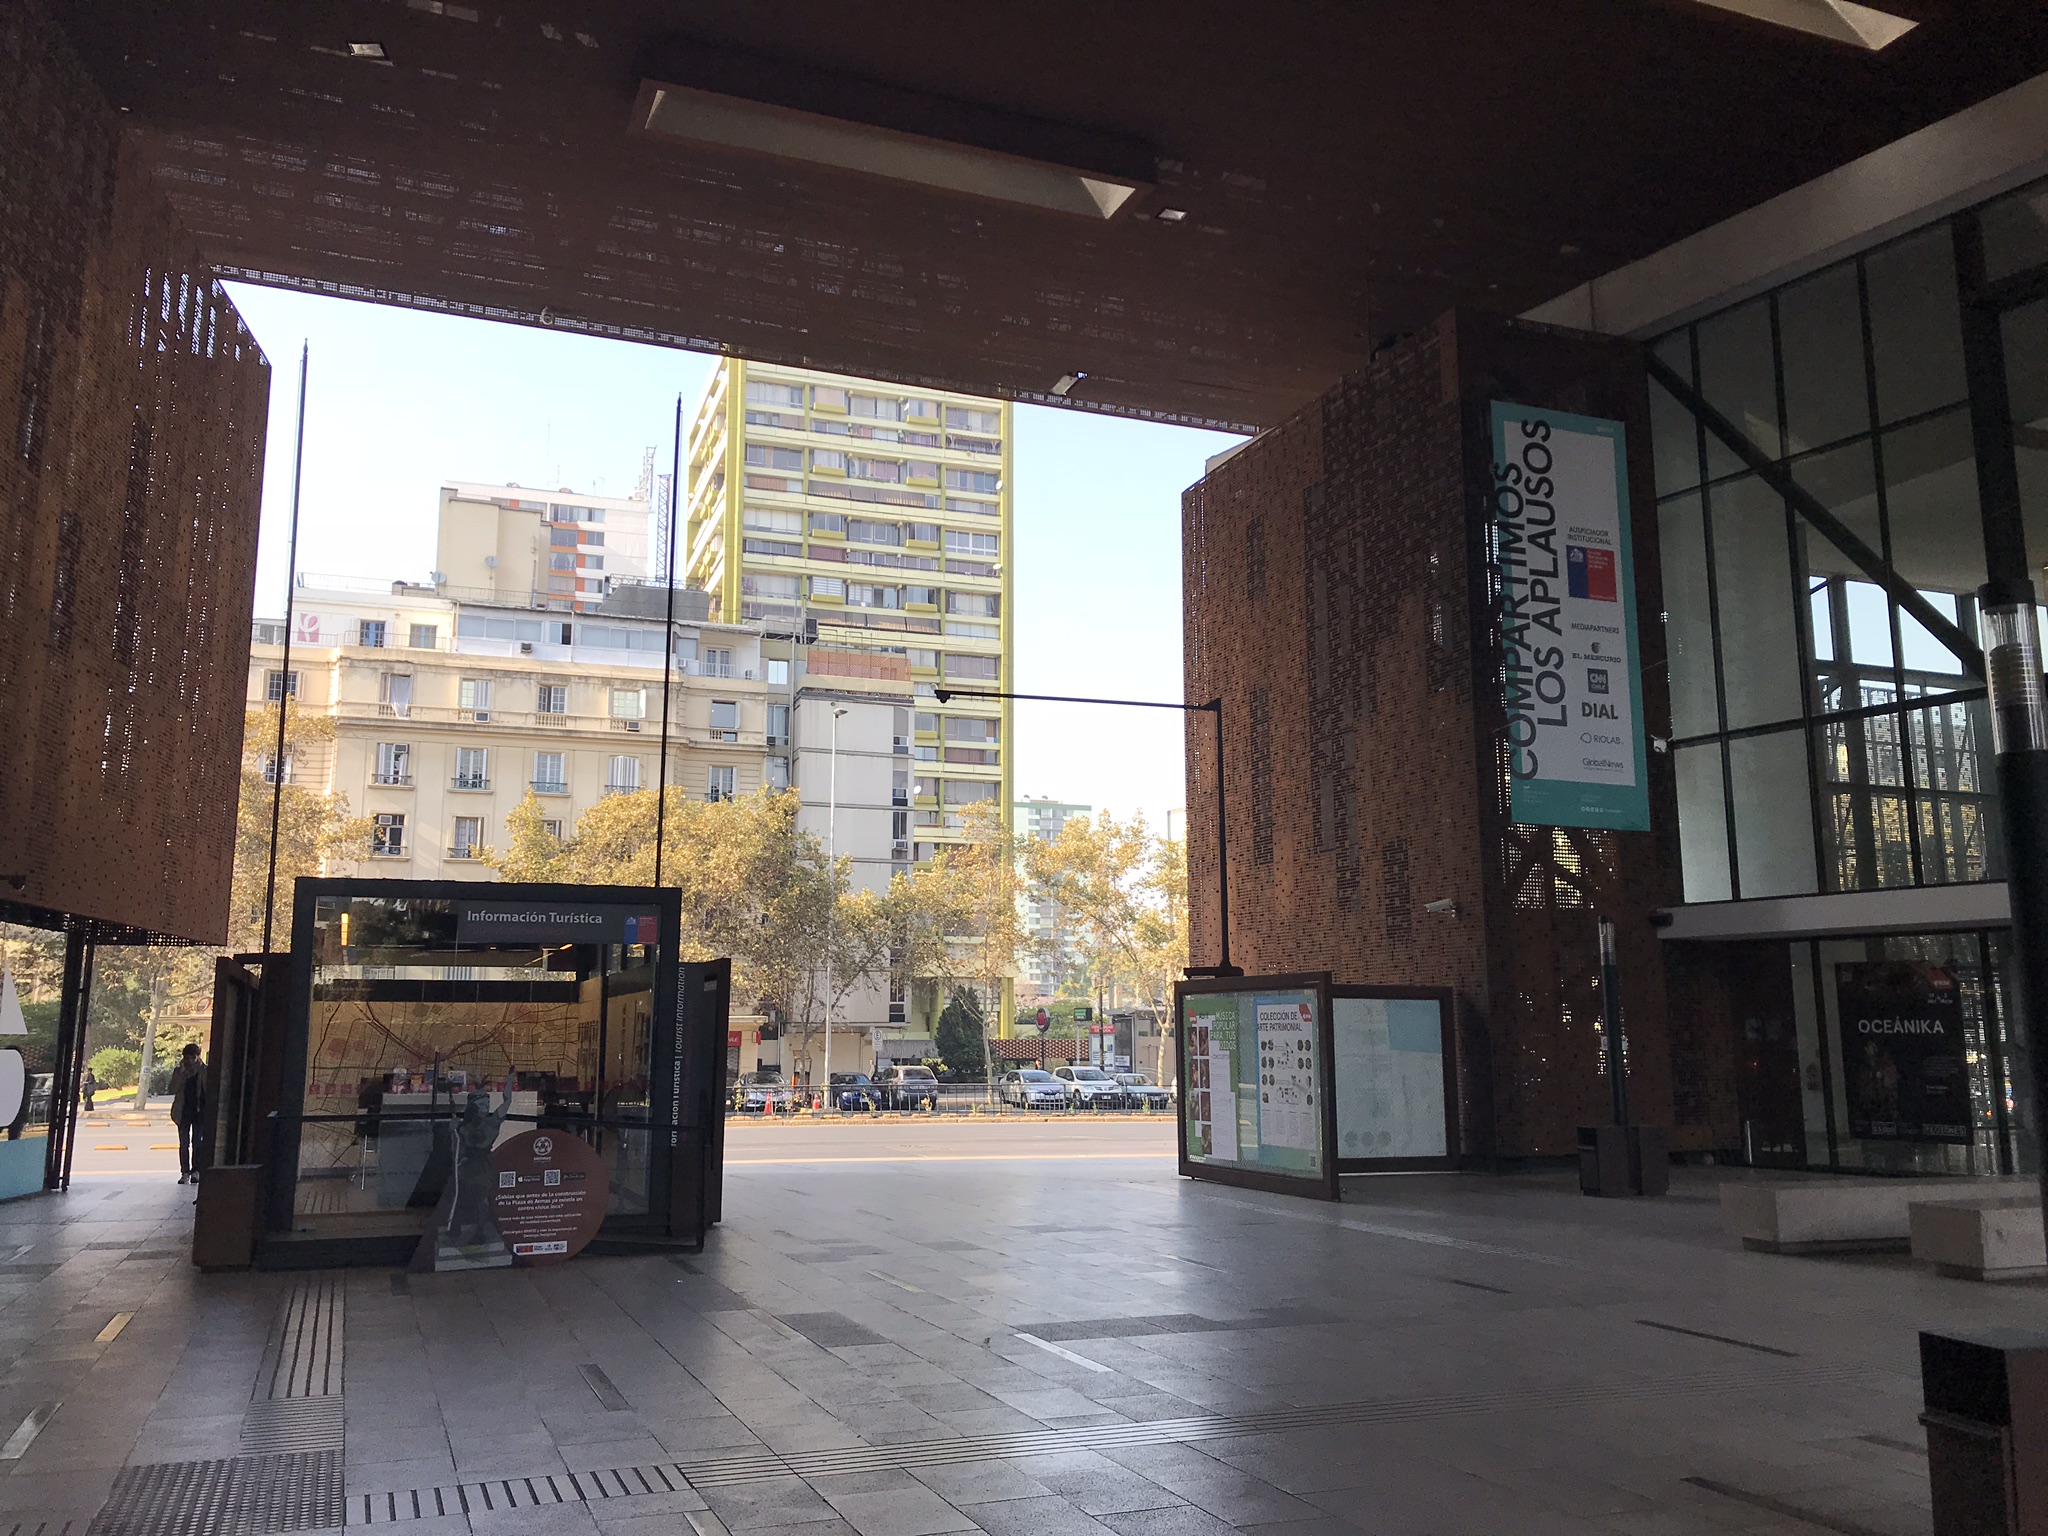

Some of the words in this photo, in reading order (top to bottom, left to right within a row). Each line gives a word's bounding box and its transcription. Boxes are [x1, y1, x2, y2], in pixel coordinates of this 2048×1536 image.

[1521, 419, 1563, 636] APLAUSOS
[1568, 526, 1610, 537] AUSPICIADOR
[1567, 534, 1612, 546] INSTITUCIONAL
[1494, 461, 1539, 781] COMPARTIMOS
[1571, 622, 1620, 635] MEDIAPARTNERS
[1584, 653, 1622, 663] MERCURIO
[1589, 672, 1607, 684] CNN
[1533, 645, 1568, 727] LOS
[1581, 701, 1619, 720] DIAL
[1582, 757, 1624, 769] GlobalNews
[467, 910, 547, 924] Información
[549, 911, 603, 925] Turística
[1259, 1009, 1290, 1021] COLECCIÓN
[1290, 1011, 1298, 1020] DE
[1212, 1021, 1236, 1031] POPULAR
[1257, 1022, 1269, 1031] ARTE
[1269, 1022, 1303, 1032] PATRIMONIAL
[1858, 1017, 1945, 1035] OCEÁNIKA
[1210, 1030, 1223, 1040] PARA
[1226, 1030, 1237, 1040] TUS
